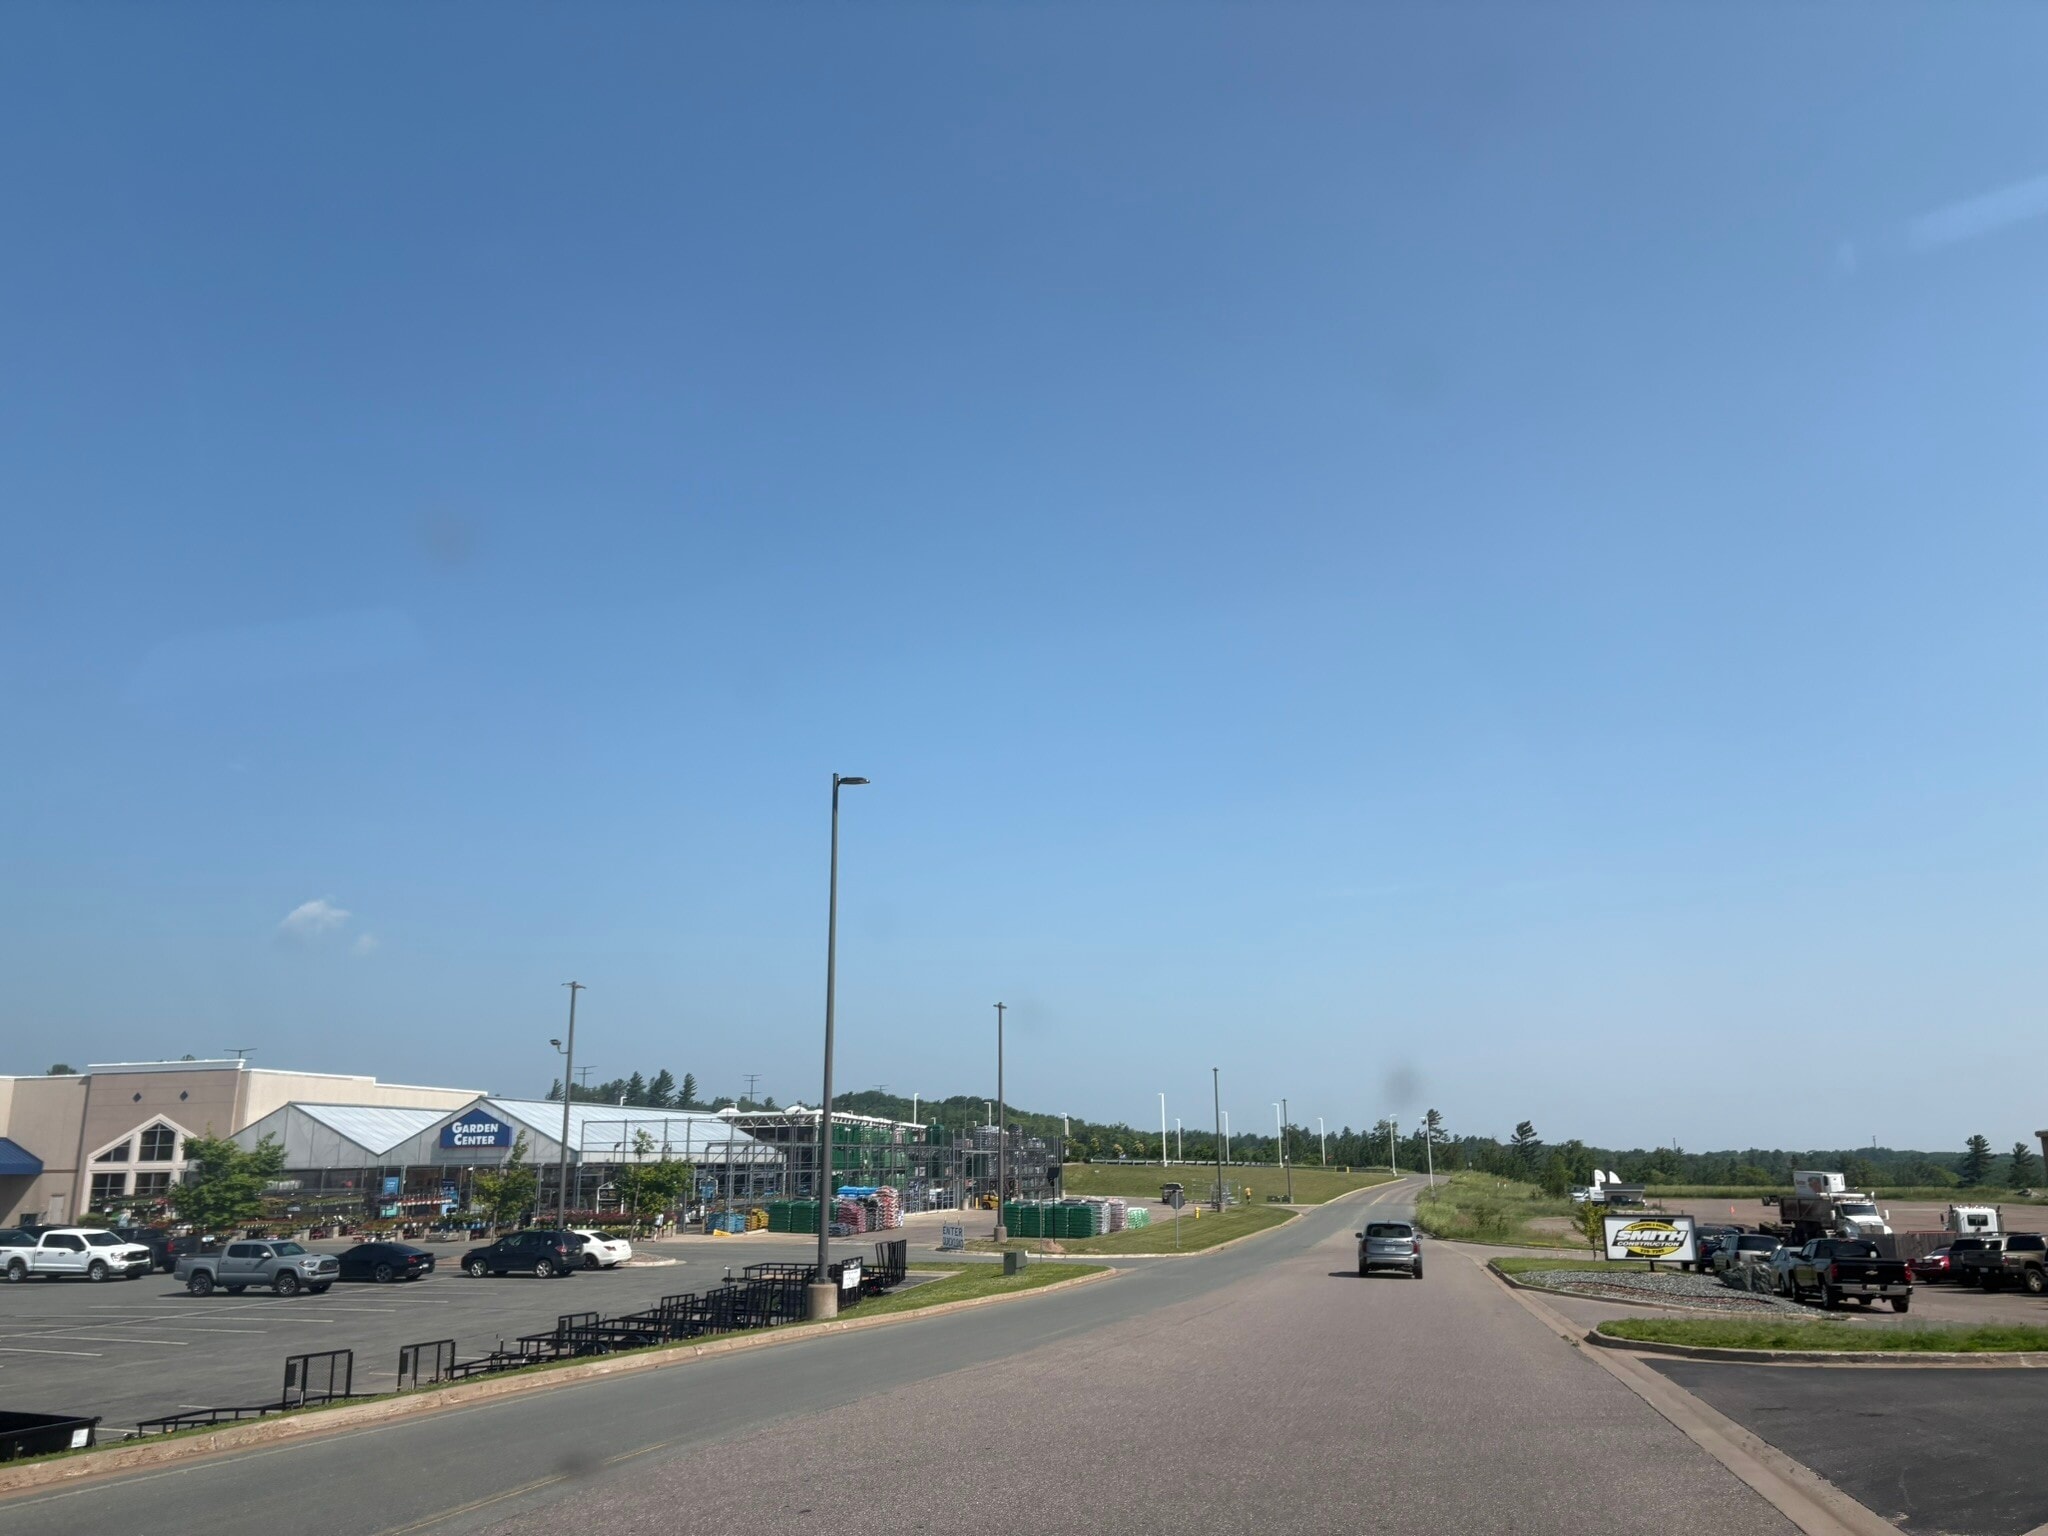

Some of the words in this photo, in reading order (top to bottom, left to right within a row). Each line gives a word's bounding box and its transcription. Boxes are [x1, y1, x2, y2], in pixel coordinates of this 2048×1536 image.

[452, 1121, 499, 1133] GARDEN
[453, 1133, 495, 1146] CENTER
[942, 1226, 963, 1237] ENTER
[1615, 1230, 1688, 1241] SMITH
